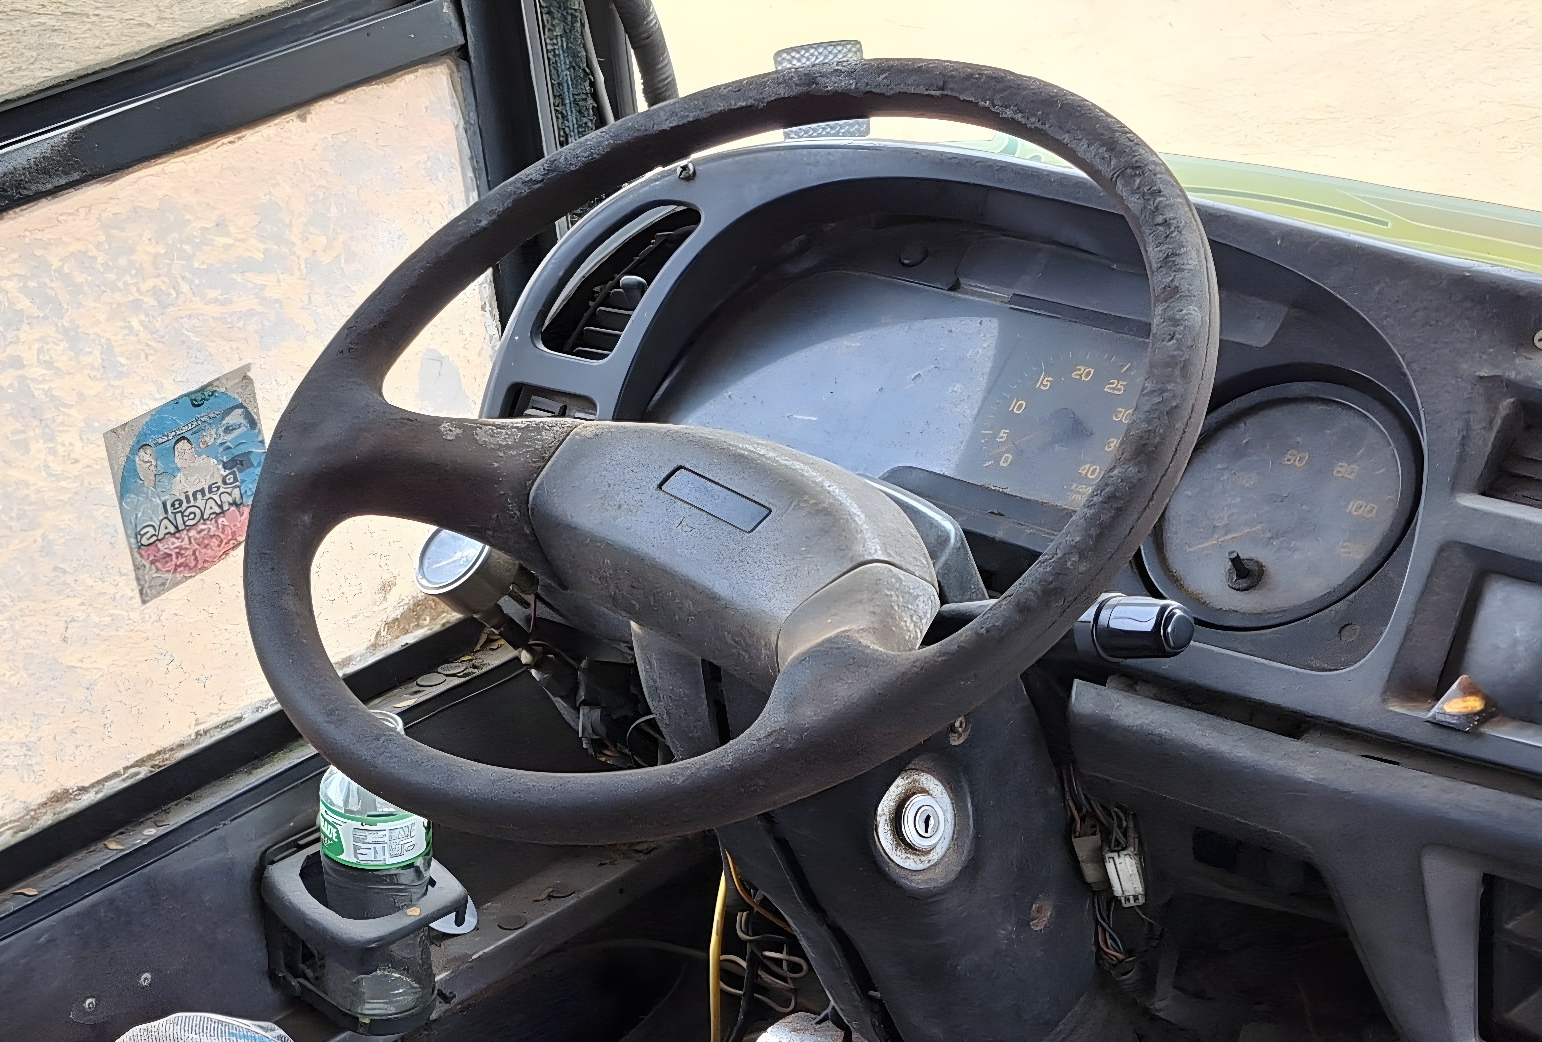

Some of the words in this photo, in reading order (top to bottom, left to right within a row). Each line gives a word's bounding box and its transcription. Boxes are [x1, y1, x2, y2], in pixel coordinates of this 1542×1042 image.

[1071, 365, 1095, 381] 20
[1036, 374, 1054, 391] 15
[1104, 379, 1128, 395] 25
[1009, 398, 1027, 414] 10
[996, 430, 1010, 442] 5
[999, 454, 1013, 467] 0
[1078, 464, 1100, 479] 40
[1347, 501, 1379, 519] 100
